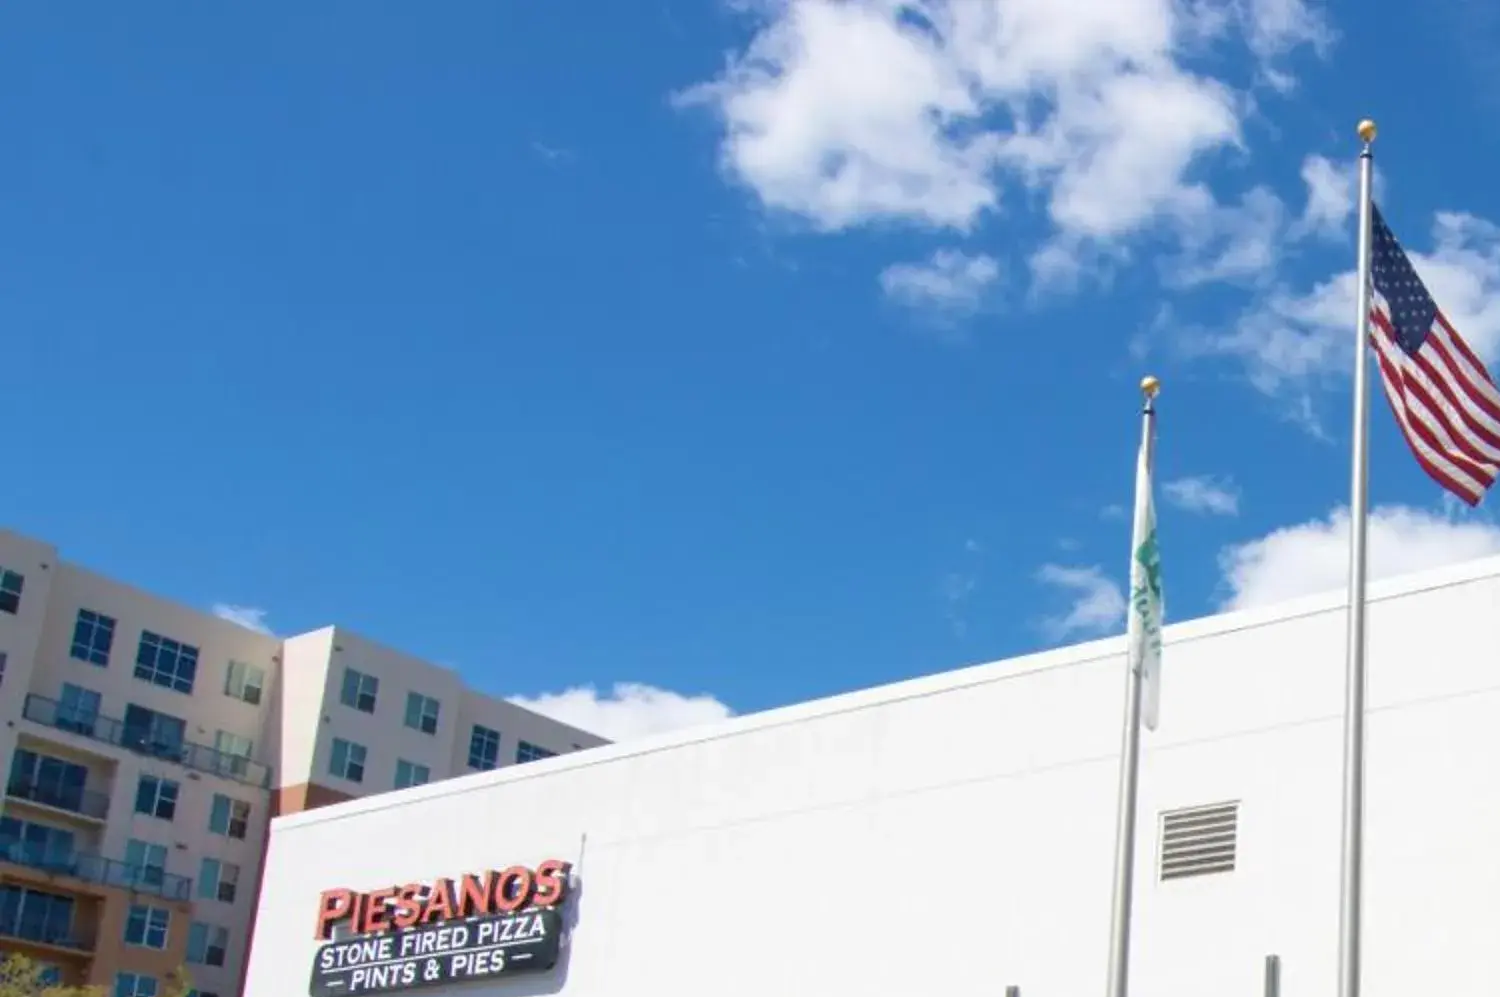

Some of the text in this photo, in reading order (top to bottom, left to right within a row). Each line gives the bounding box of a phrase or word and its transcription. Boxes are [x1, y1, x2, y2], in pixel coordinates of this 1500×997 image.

[314, 859, 568, 941] PIESANOS
[321, 915, 546, 969] STONE FIRED PIZZA
[350, 950, 506, 991] PINTS & PIES
